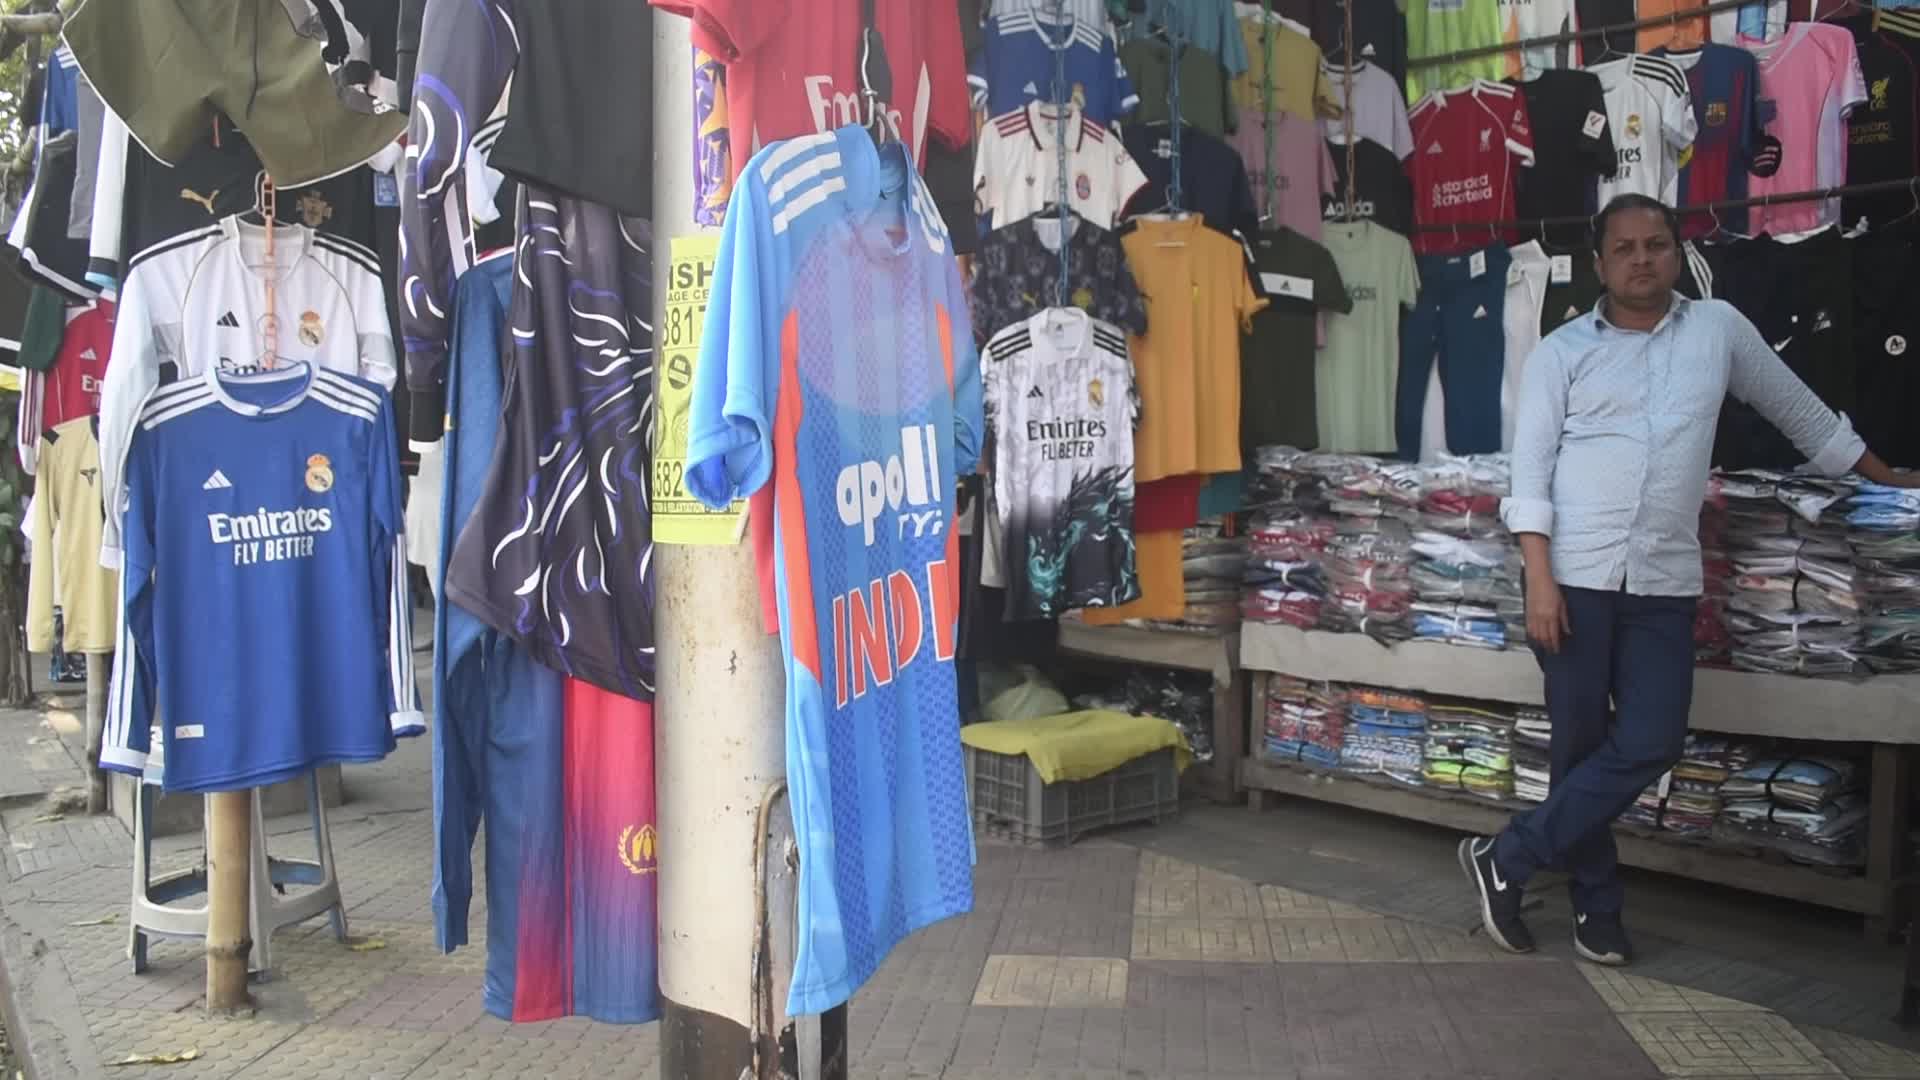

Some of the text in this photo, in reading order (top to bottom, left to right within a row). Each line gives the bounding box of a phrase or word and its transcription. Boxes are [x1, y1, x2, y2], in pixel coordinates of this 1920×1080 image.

[208, 506, 332, 543] Emirates
[234, 536, 314, 566] FLY BETTER
